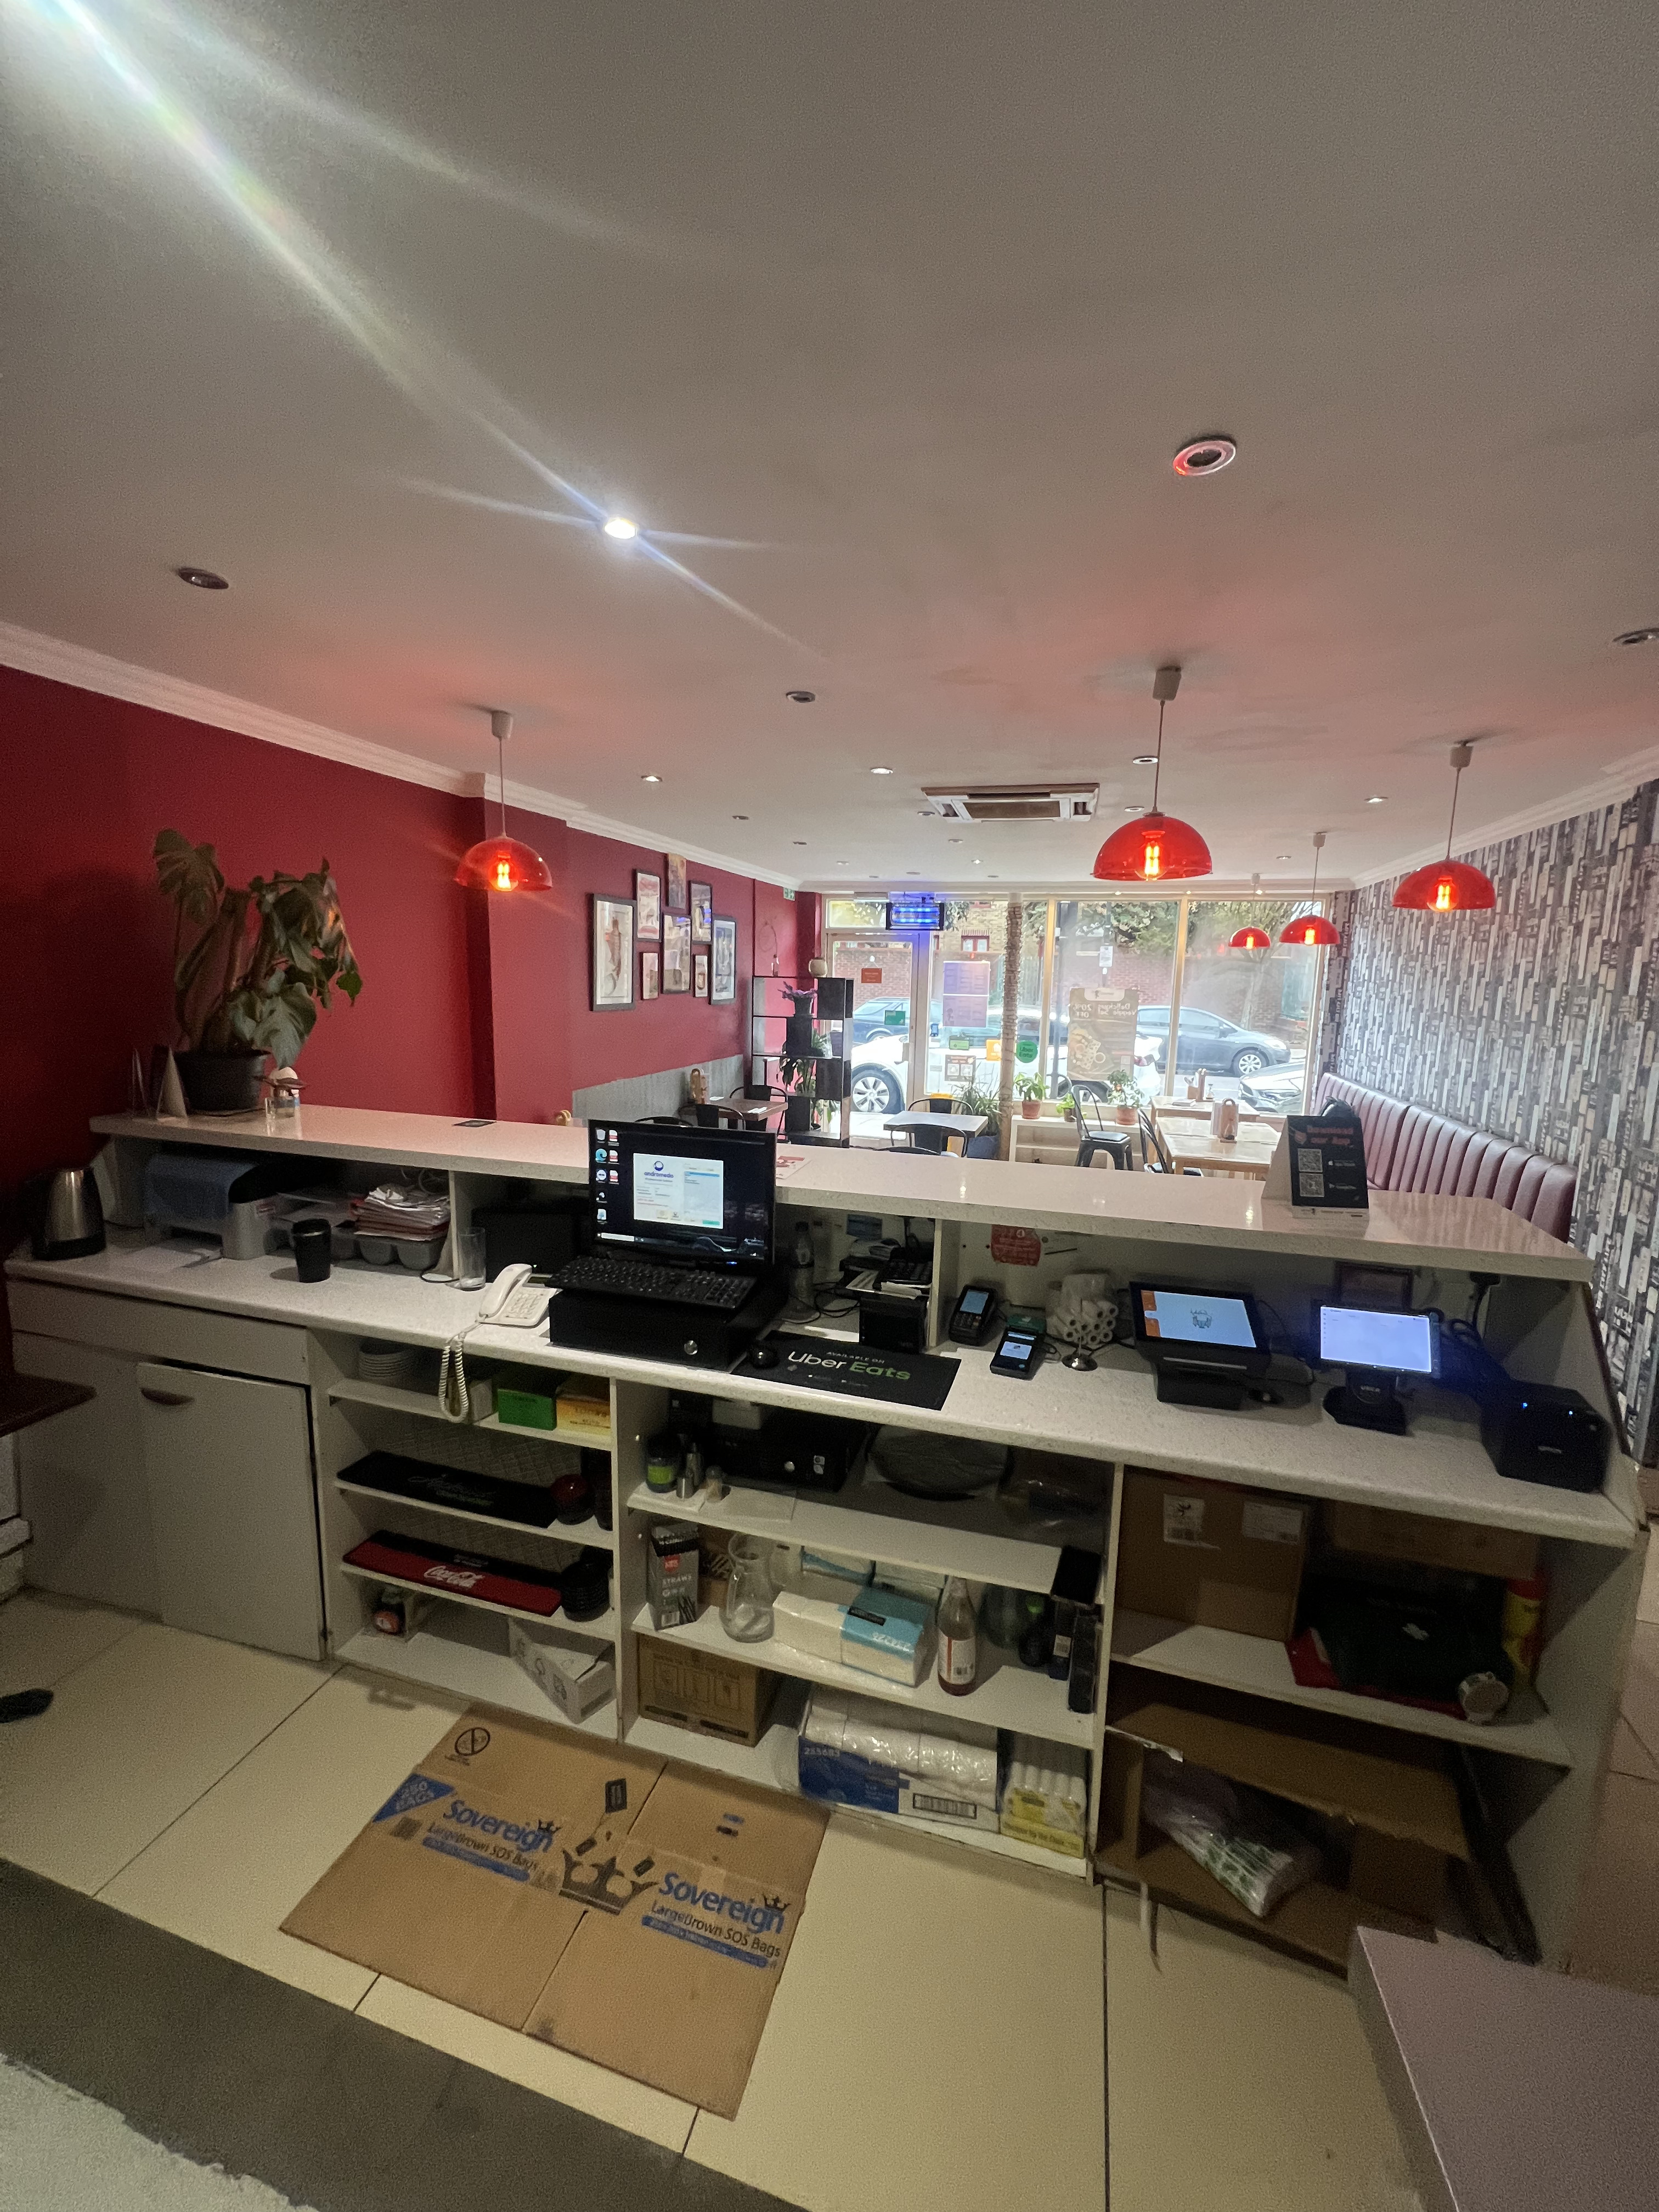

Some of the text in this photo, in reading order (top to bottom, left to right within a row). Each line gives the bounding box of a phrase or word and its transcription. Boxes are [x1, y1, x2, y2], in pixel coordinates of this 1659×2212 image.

[788, 1351, 911, 1381] Uber Eats
[826, 1351, 870, 1362] AVAILABLE
[443, 1799, 554, 1853] Sovereign
[658, 1870, 785, 1934] Sovereign
[724, 1927, 748, 1946] SOS
[751, 1936, 781, 1958] Bags
